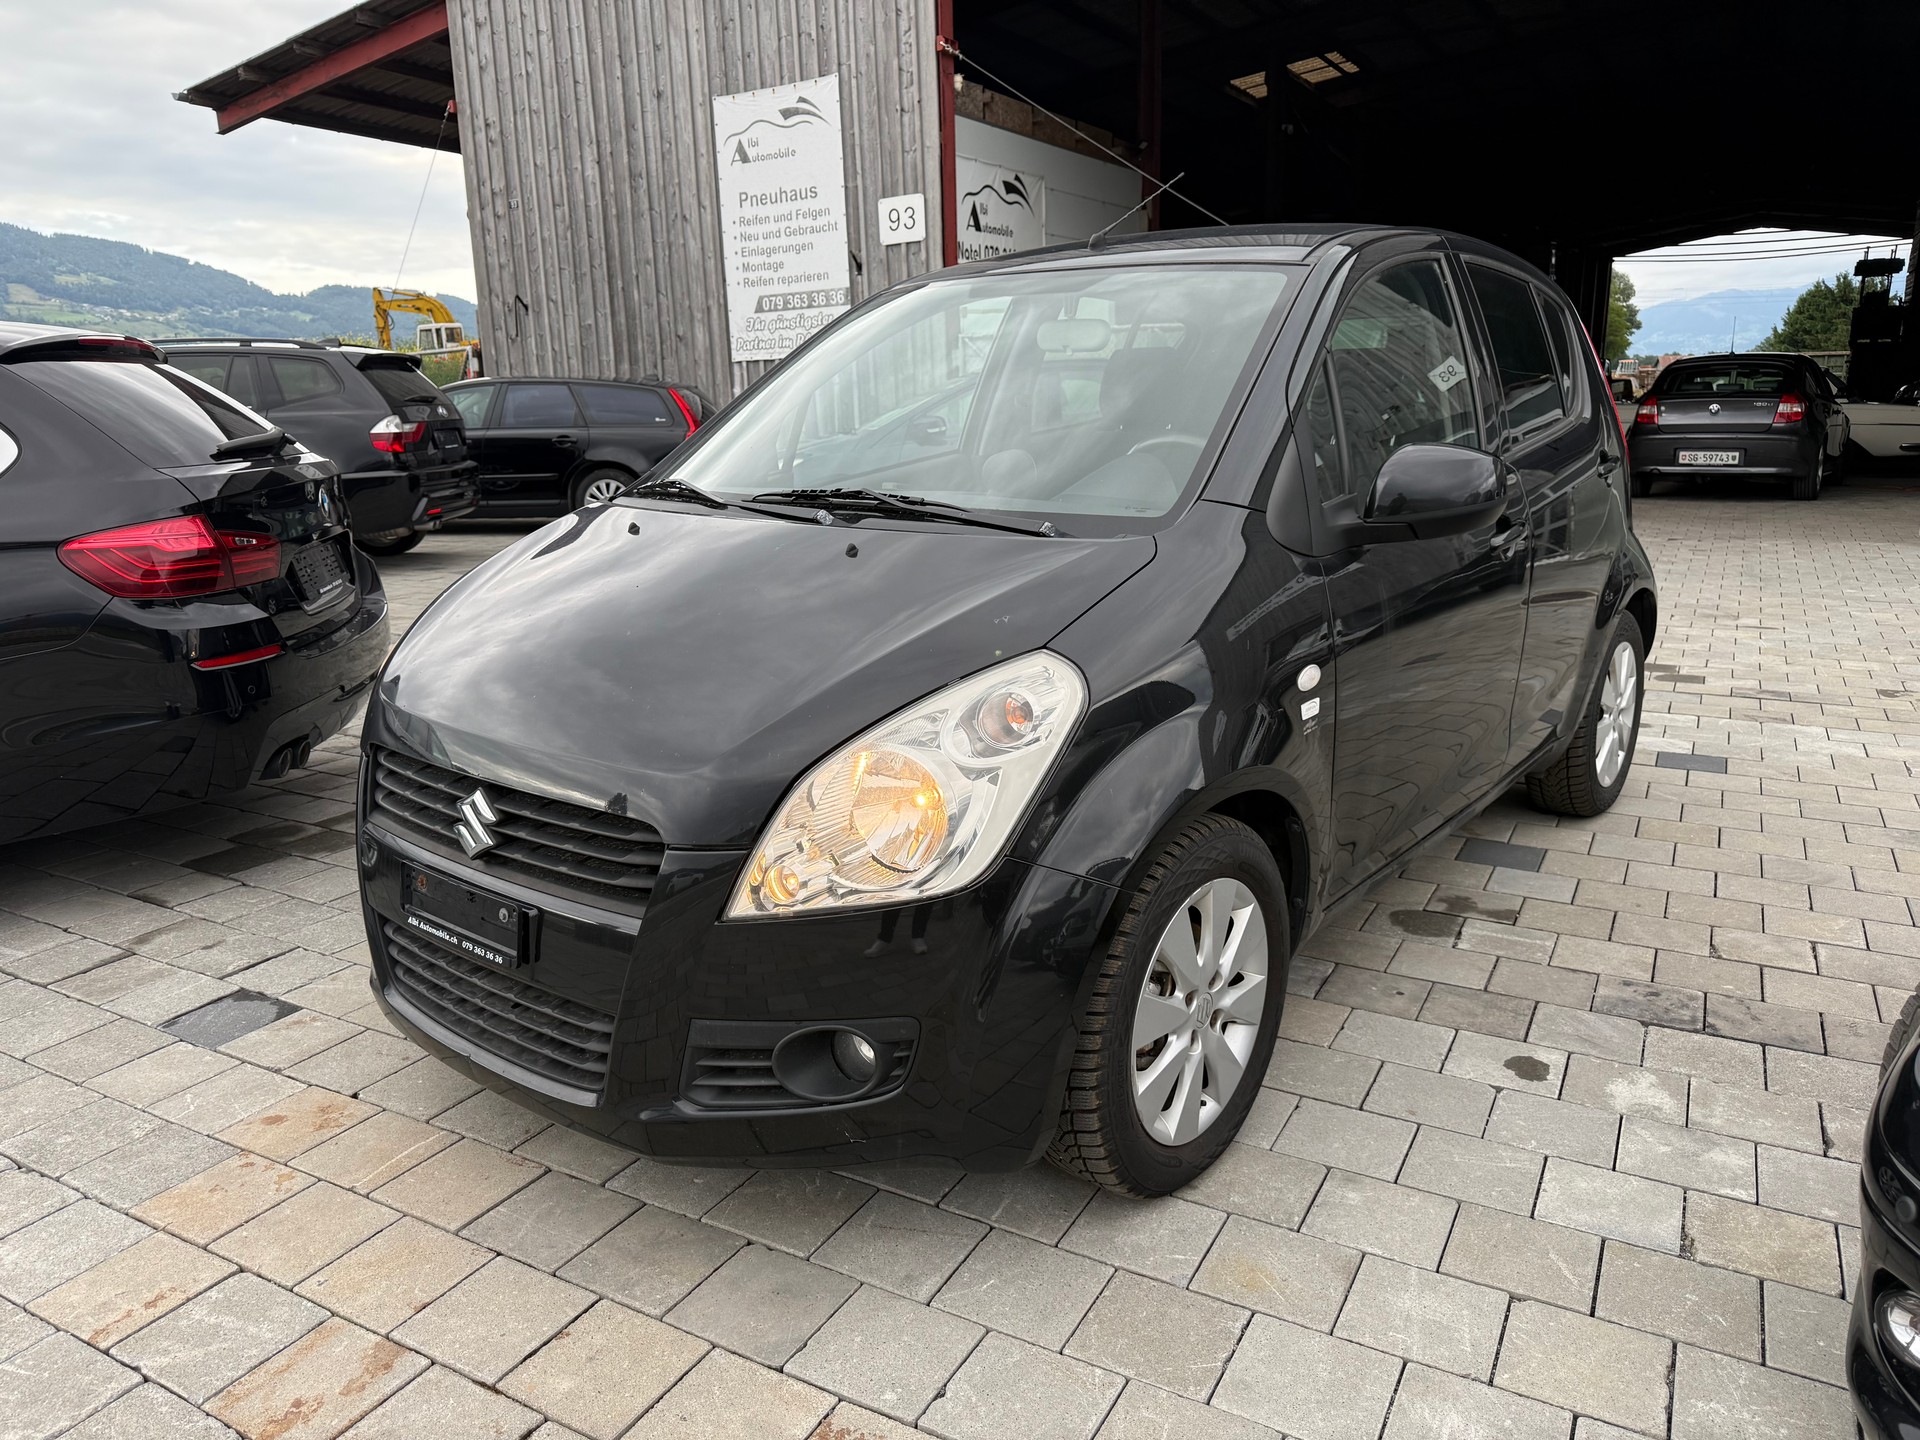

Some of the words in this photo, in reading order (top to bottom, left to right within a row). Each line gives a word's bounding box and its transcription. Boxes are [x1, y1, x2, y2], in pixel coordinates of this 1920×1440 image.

[739, 186, 818, 208] Pneuhaus
[739, 214, 770, 227] Reifen
[773, 210, 793, 222] und
[795, 207, 830, 220] Felgen
[889, 206, 915, 231] 93
[740, 231, 759, 242] Neu
[762, 228, 781, 240] und
[784, 221, 838, 237] Gebraucht
[741, 242, 814, 257] Einlagerungen
[957, 241, 981, 260] Natel
[742, 260, 784, 273] Montage
[743, 276, 774, 288] Reifen
[777, 271, 829, 287] reparieren
[762, 296, 784, 310] 079
[787, 294, 808, 309] 363
[811, 292, 826, 307] 36
[829, 290, 844, 304] 36
[736, 336, 776, 352] Partner
[778, 334, 793, 349] im
[407, 916, 419, 927] Albi
[420, 921, 458, 945] Automobile.ch
[461, 941, 473, 951] 079
[473, 946, 485, 957] 363
[485, 951, 494, 960] 36
[494, 955, 503, 964] 36
